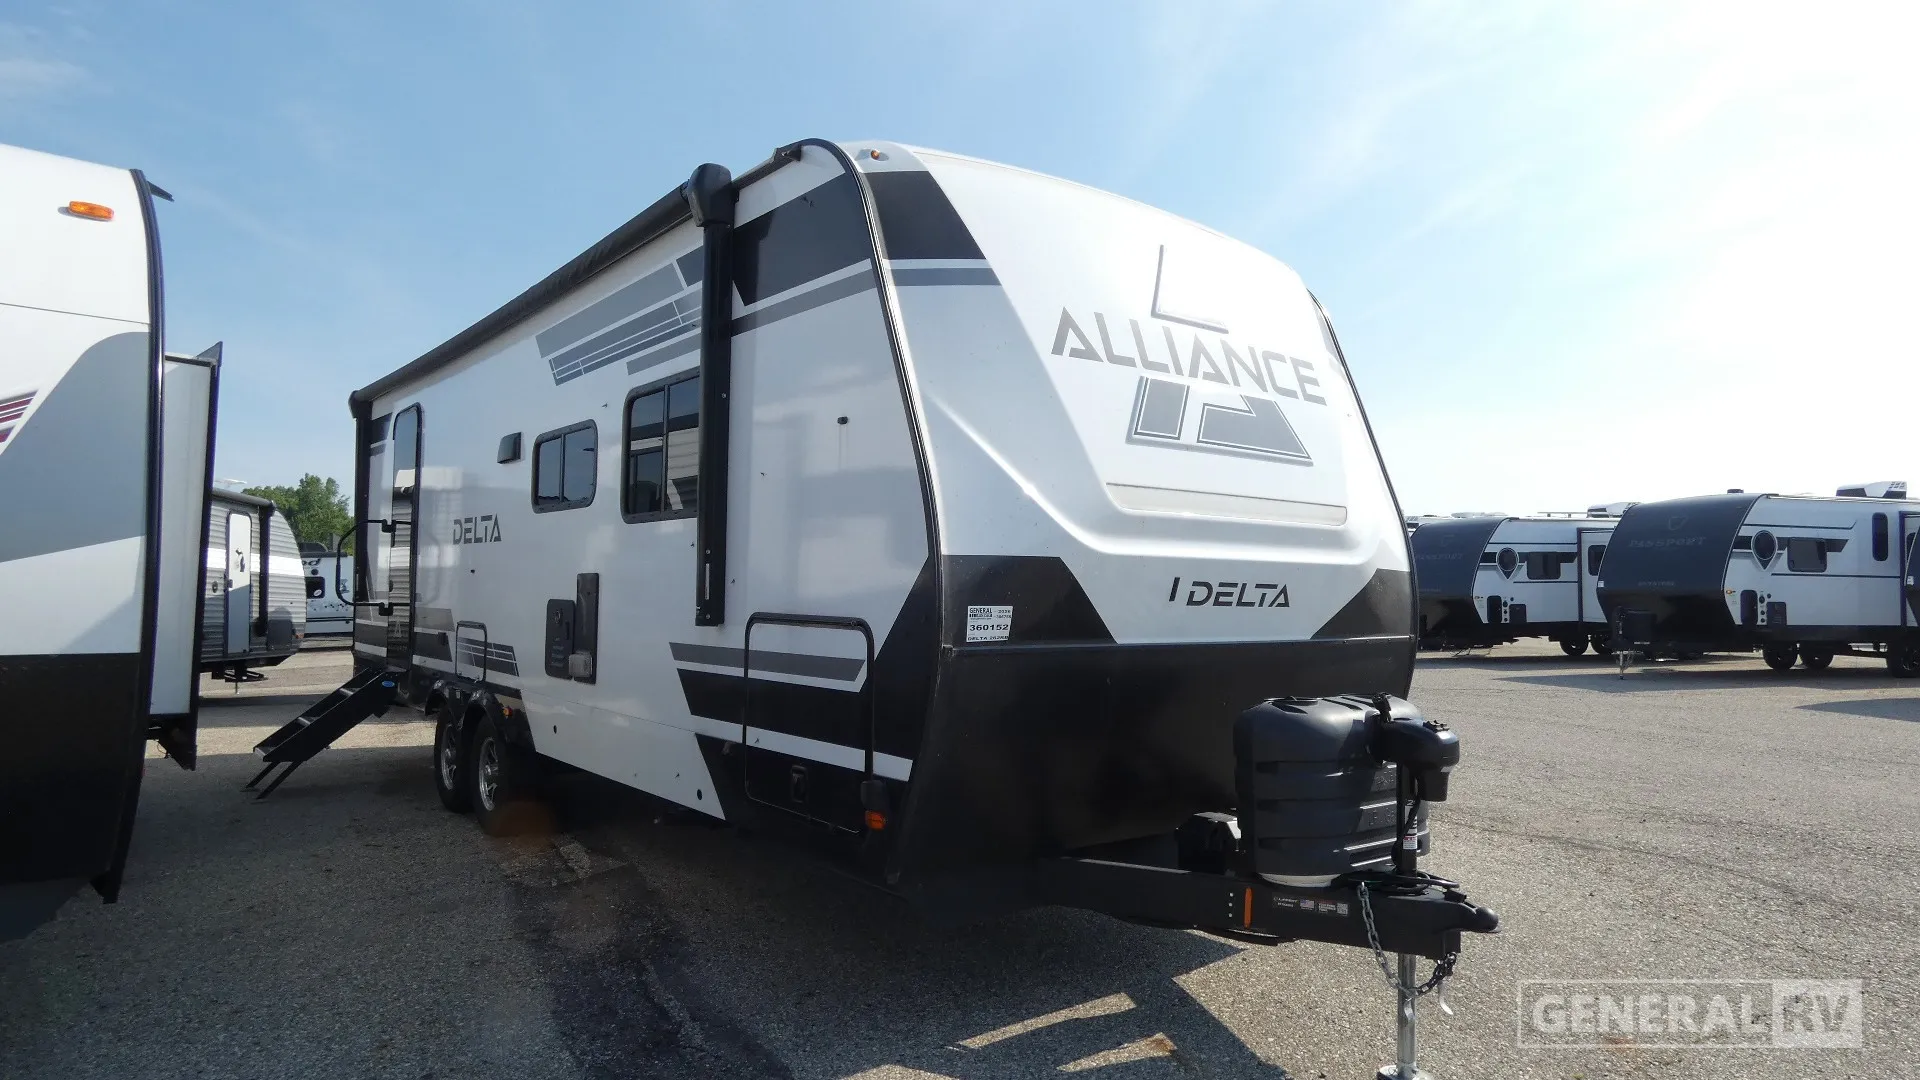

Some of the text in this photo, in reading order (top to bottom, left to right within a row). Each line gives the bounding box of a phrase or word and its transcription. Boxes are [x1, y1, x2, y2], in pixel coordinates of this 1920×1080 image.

[1051, 306, 1327, 406] ALLIANCE
[453, 513, 502, 545] DELTA
[1186, 580, 1290, 607] DELTA
